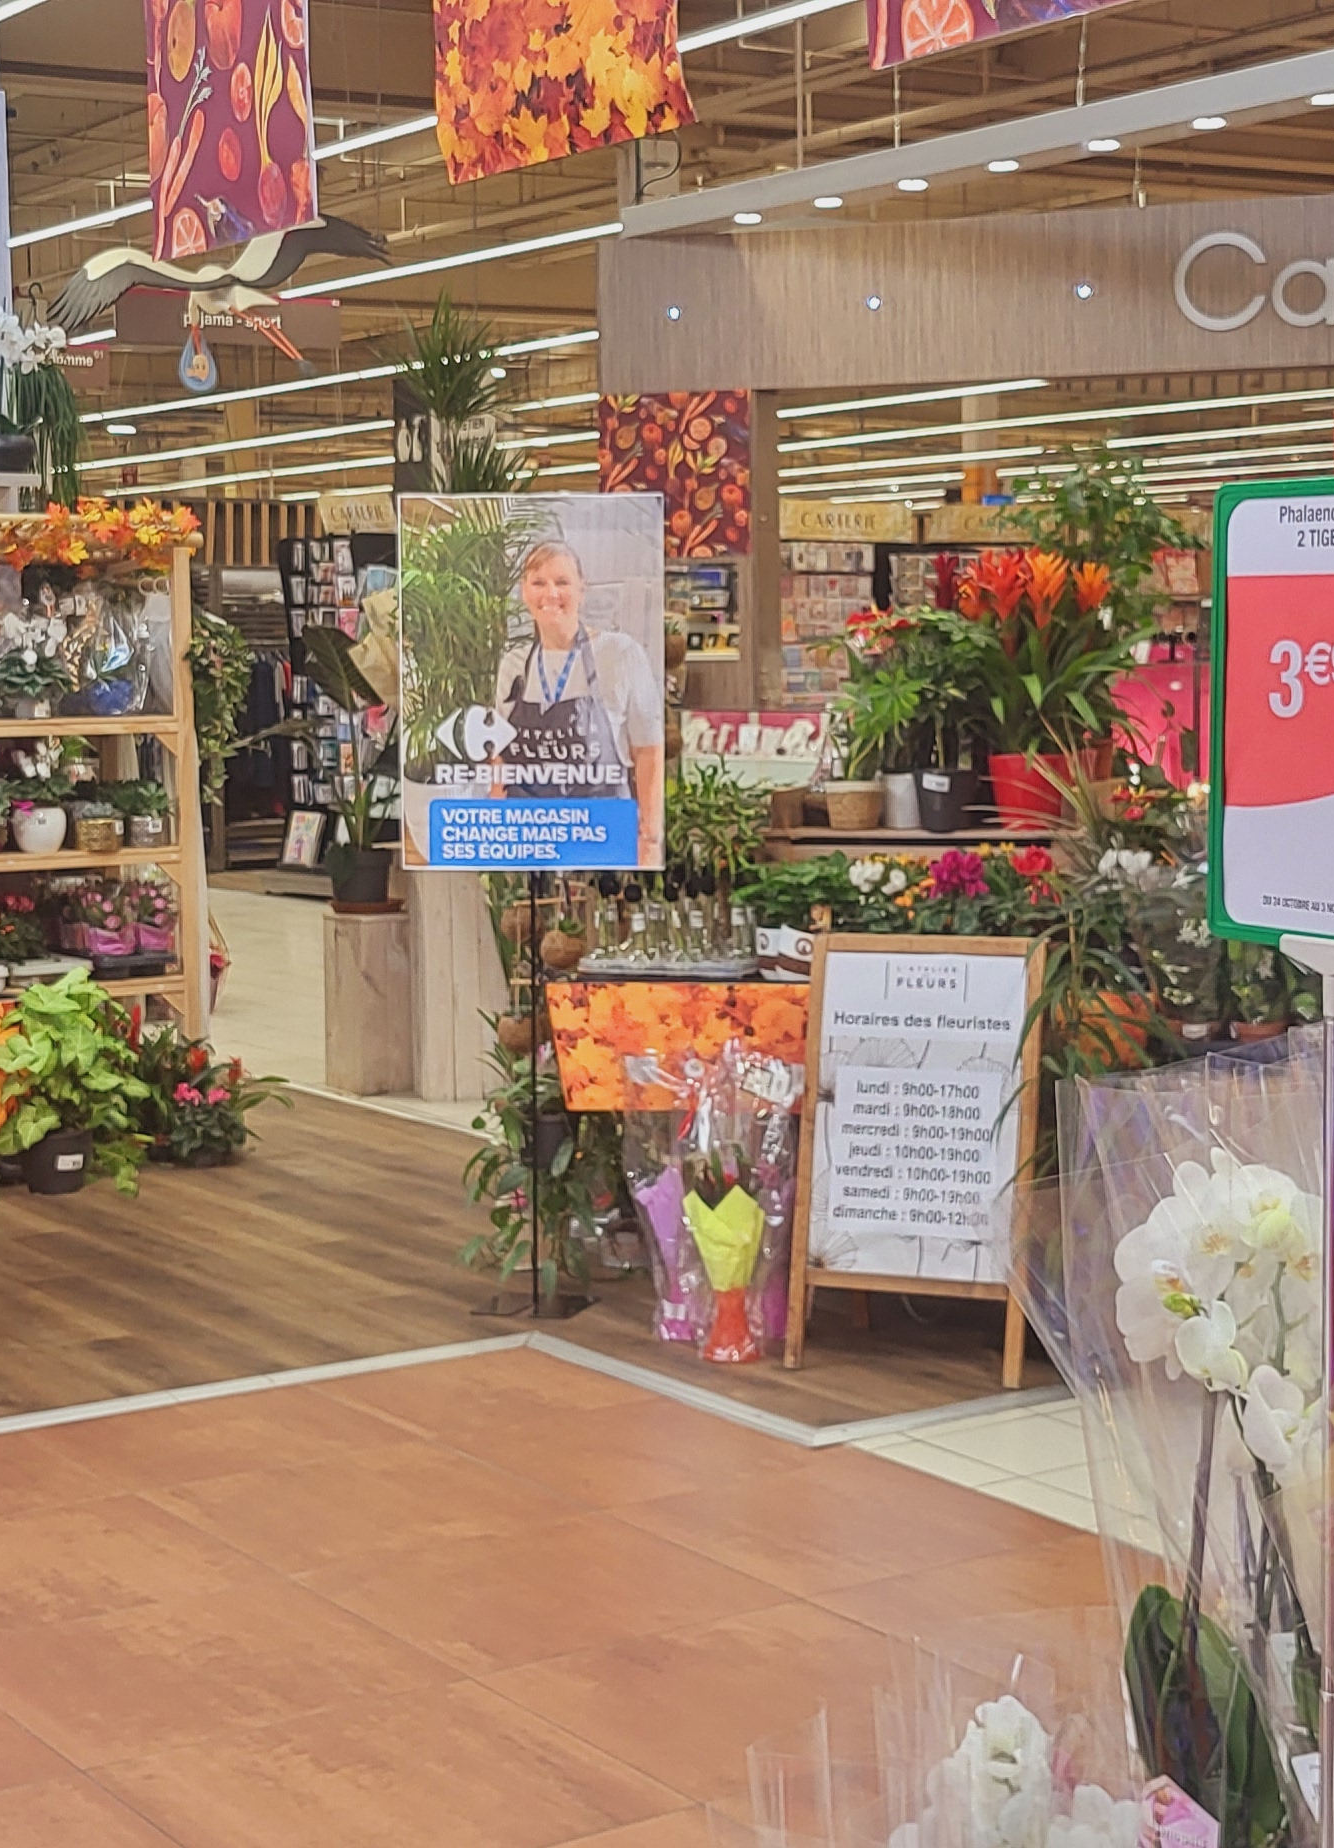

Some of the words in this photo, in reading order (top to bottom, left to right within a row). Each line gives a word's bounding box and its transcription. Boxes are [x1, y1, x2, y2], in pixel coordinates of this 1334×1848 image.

[183, 312, 234, 329] pjama
[1296, 530, 1306, 547] 2
[518, 723, 599, 739] 'ATELIER
[510, 742, 601, 760] FLEURS
[441, 808, 502, 825] VOTRE
[506, 808, 590, 825] MAGASIN
[441, 826, 519, 842] CHANGE
[523, 826, 568, 842] MAIS
[572, 826, 608, 842] PAS
[442, 844, 476, 860] SES
[479, 842, 561, 861] ÉQUIPES.
[896, 976, 957, 989] FLEURS
[833, 1010, 899, 1027] Horaires
[904, 1013, 932, 1028] des
[937, 1015, 1011, 1031] fleuristes
[856, 1080, 890, 1095] lundi
[901, 1082, 980, 1100] 9h00-17h00
[853, 1103, 891, 1116] mardi
[841, 1123, 900, 1137] mercredi
[848, 1141, 882, 1159] jeudi
[835, 1164, 893, 1179] vendredi
[842, 1186, 890, 1200] samedi
[832, 1204, 898, 1221] dimanche
